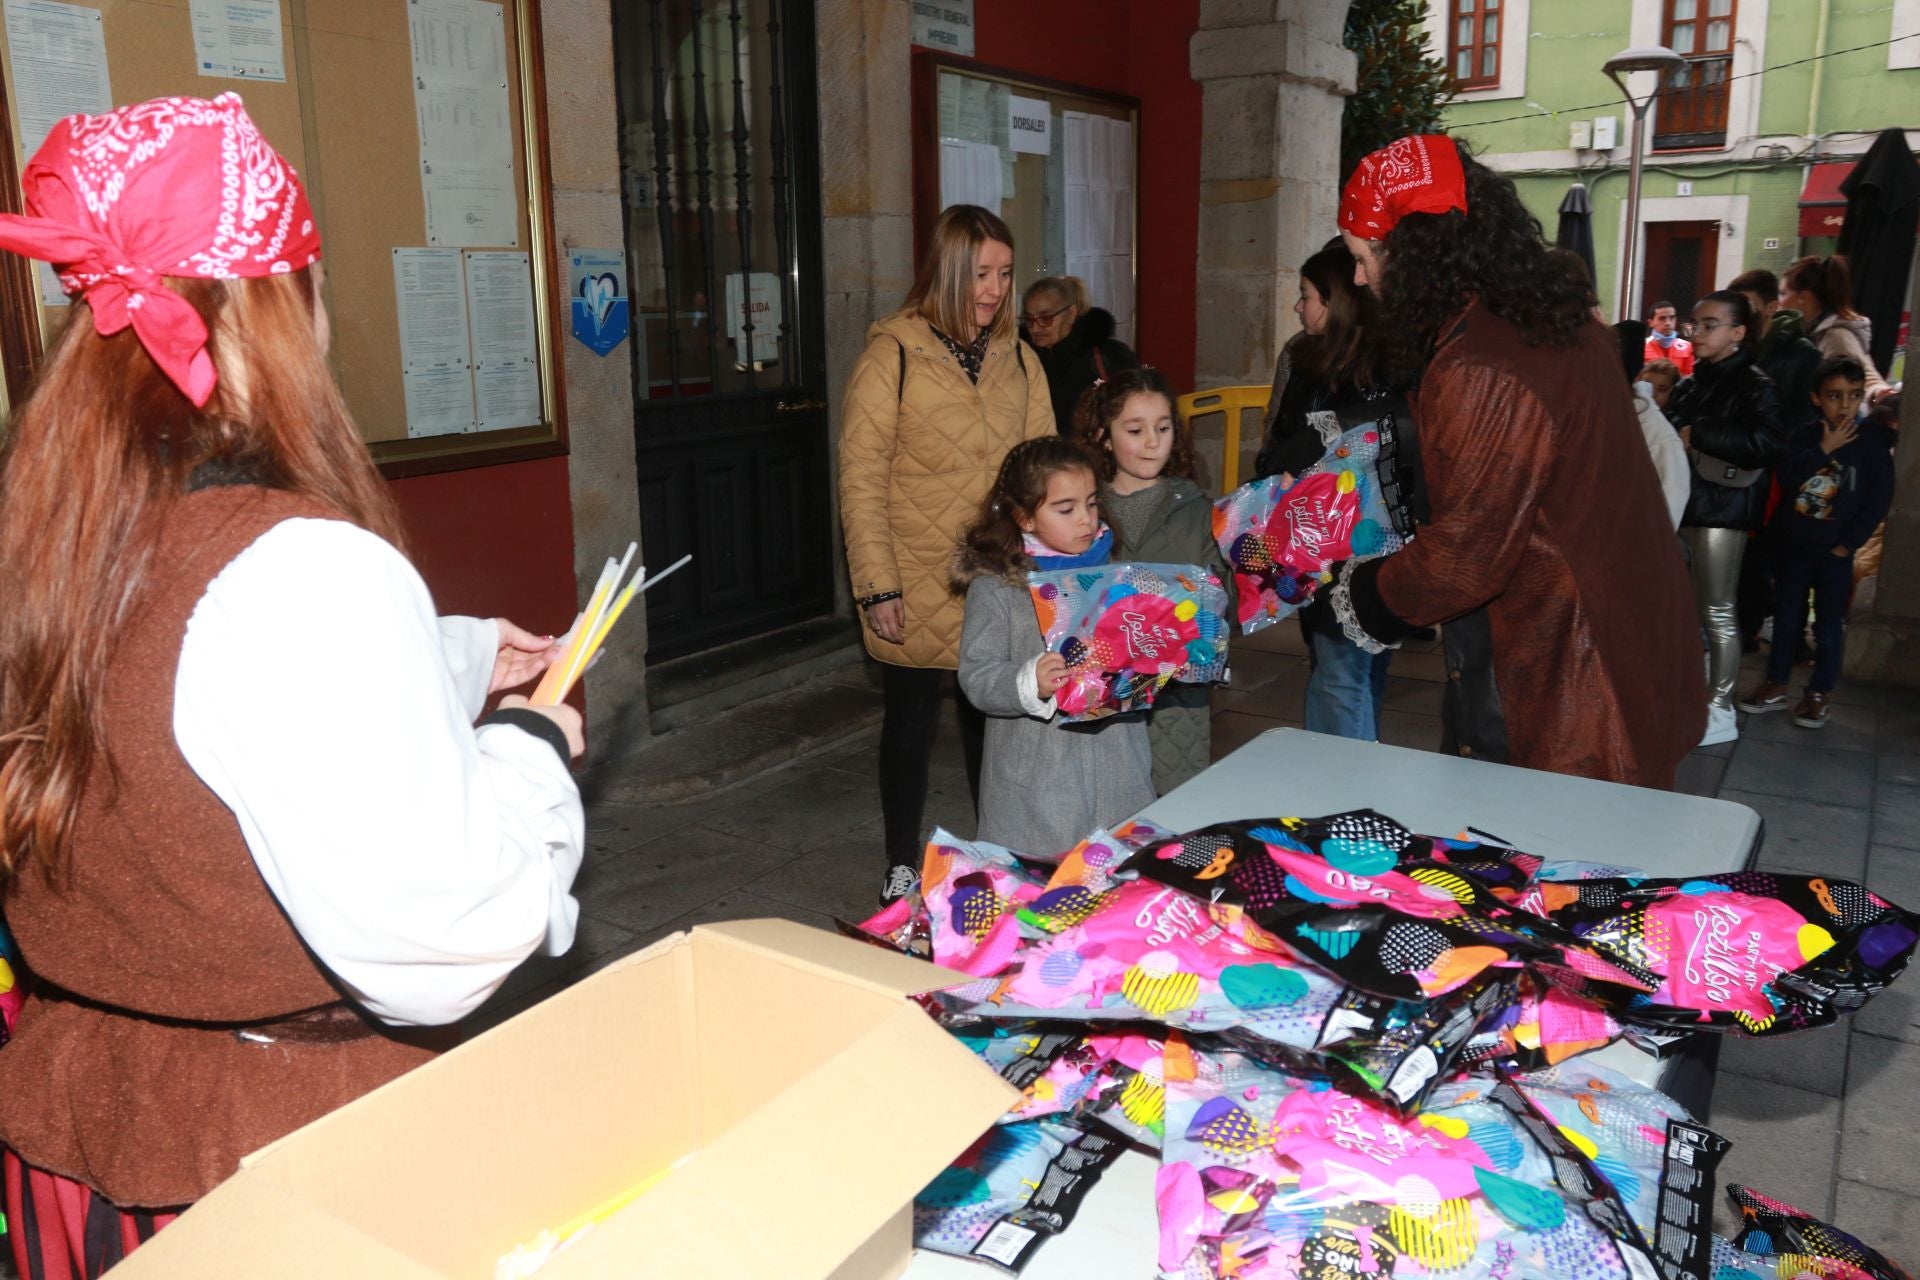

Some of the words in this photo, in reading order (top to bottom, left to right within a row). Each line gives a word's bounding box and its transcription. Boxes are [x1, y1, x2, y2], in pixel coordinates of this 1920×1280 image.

[1013, 116, 1046, 133] DORSALES
[639, 188, 647, 202] 5
[741, 302, 770, 314] SLIDA
[1701, 904, 1742, 1004] Cotillón
[1745, 930, 1761, 969] PARTY
[1744, 970, 1758, 992] KIT
